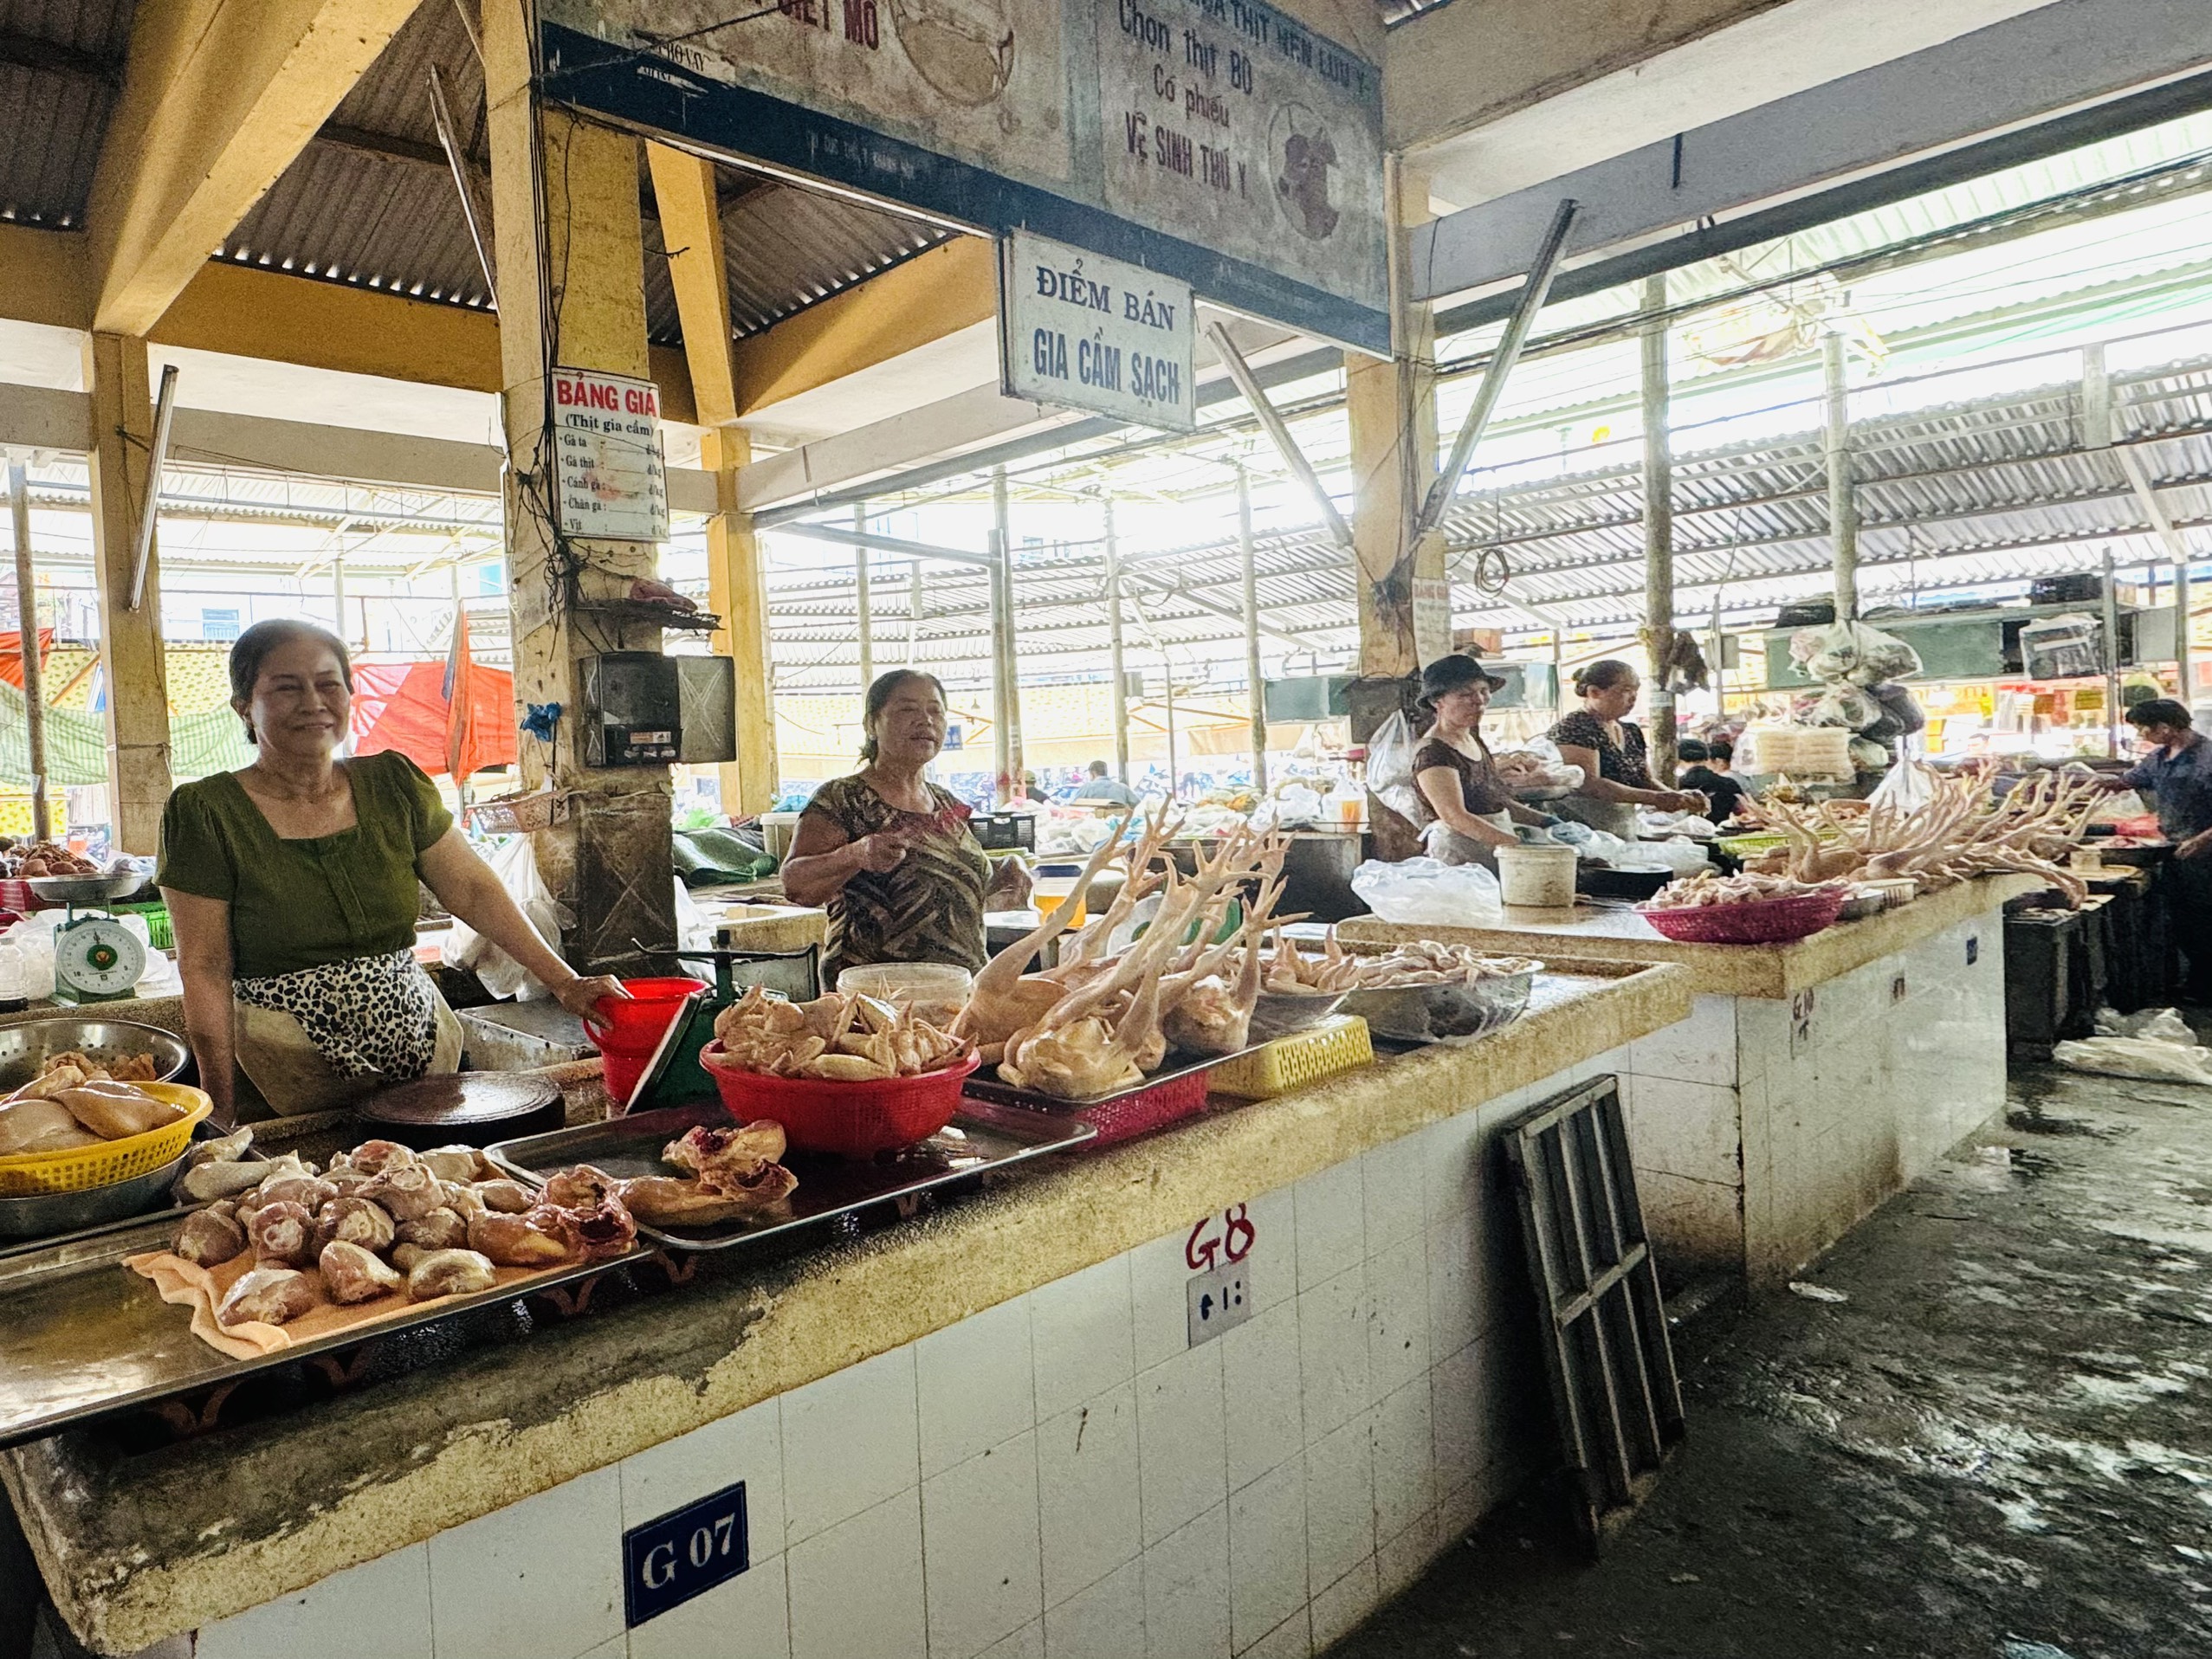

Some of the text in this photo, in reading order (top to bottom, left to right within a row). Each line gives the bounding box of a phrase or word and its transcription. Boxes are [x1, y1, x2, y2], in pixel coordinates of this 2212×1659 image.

[1155, 125, 1193, 179] SINH
[1036, 258, 1175, 332] ĐIỂM BÁN
[557, 371, 656, 417] BẢNG GIÁ
[1034, 326, 1180, 408] GIA CẦM SẠCH
[579, 436, 587, 448] ta
[603, 419, 623, 433] gia
[643, 1512, 735, 1590] G 07
